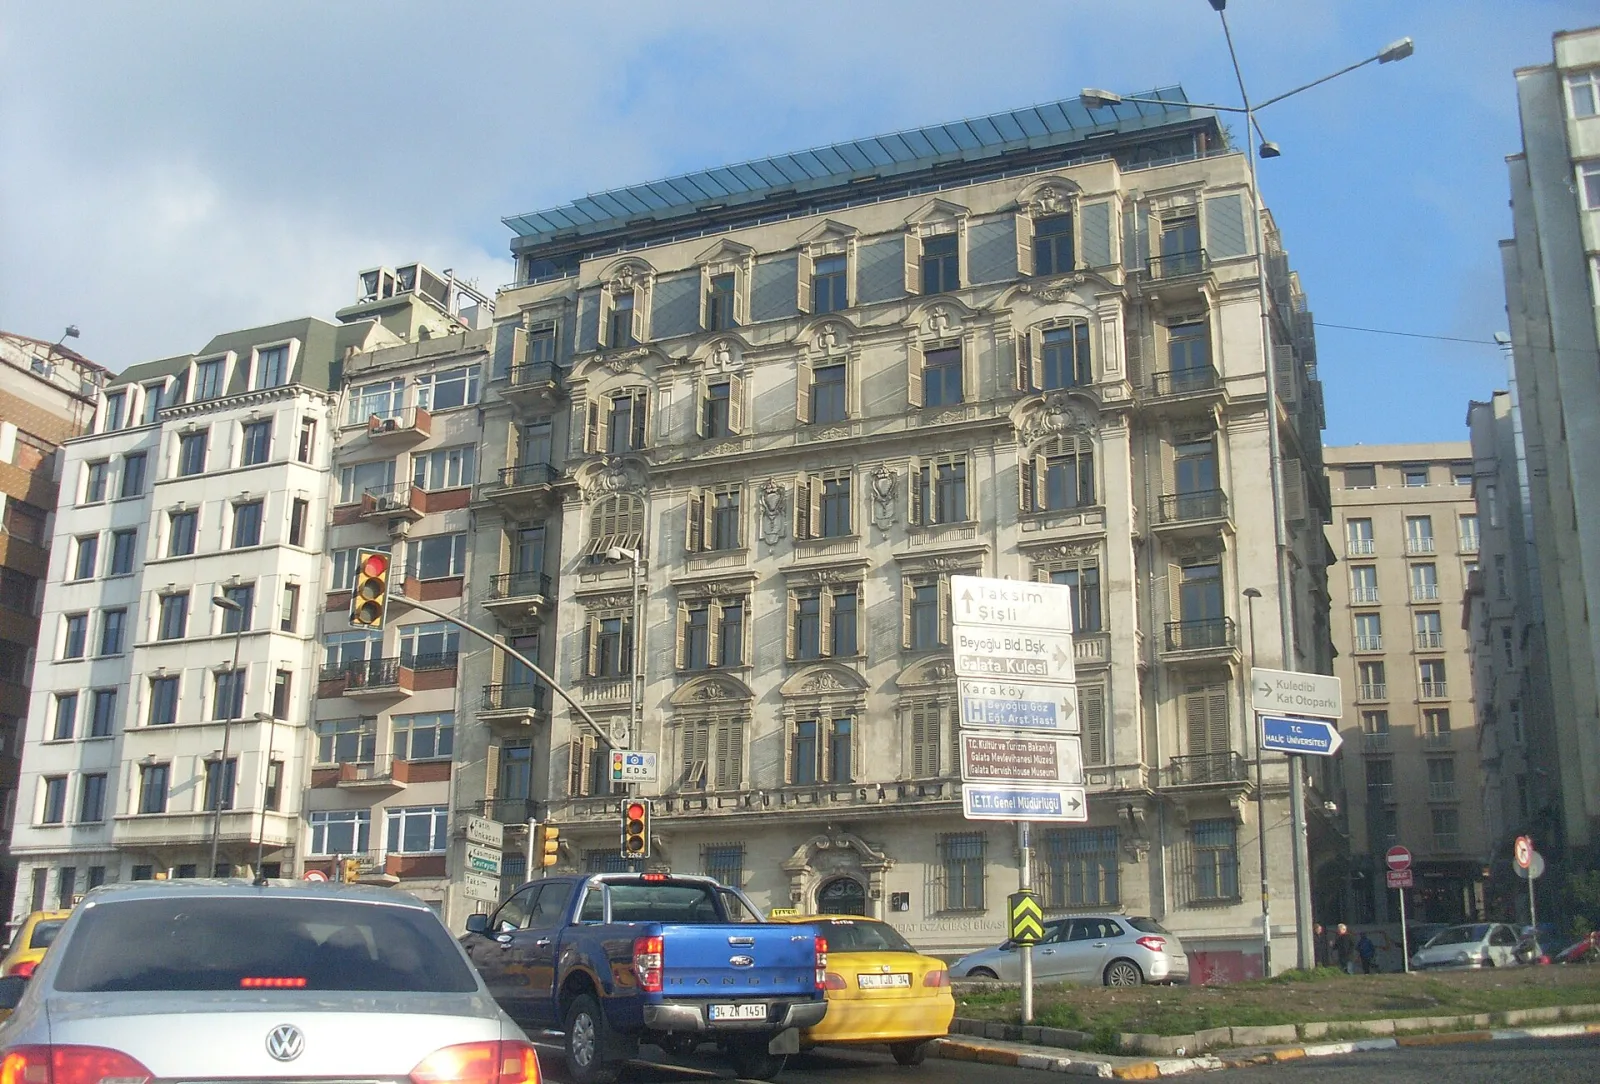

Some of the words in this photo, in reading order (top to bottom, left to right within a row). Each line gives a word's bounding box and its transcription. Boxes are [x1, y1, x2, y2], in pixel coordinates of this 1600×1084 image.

[979, 586, 1043, 603] Taksim
[979, 605, 1017, 621] Şişli
[960, 635, 1001, 653] Beyoğlu
[1004, 638, 1024, 651] Bld.
[1025, 639, 1049, 654] Bşk.
[960, 655, 1000, 672] Galata
[1006, 658, 1048, 675] Kulesi
[963, 682, 1025, 699] Karaköy
[1276, 680, 1316, 692] Kuledibi
[987, 700, 1027, 712] Beyoğlu
[1276, 694, 1293, 704] Kat
[1296, 695, 1336, 708] Otoparkı
[998, 743, 1006, 751] ve
[1006, 741, 1027, 752] Turizm
[1266, 734, 1285, 744] HALİÇ
[1286, 735, 1328, 748] ÜNİVERSİTESİ
[971, 752, 990, 762] Galata
[992, 752, 1032, 764] Mevlevihanesi
[1034, 754, 1054, 765] Müzesi
[989, 765, 1012, 775] Dervish
[1012, 766, 1030, 777] House
[994, 794, 1016, 809] Genel
[1018, 794, 1059, 813] Müdürlüğü
[670, 977, 809, 985] RANGER
[715, 1006, 725, 1018] 34
[729, 1006, 740, 1017] ZN
[745, 1005, 765, 1017] 1451
